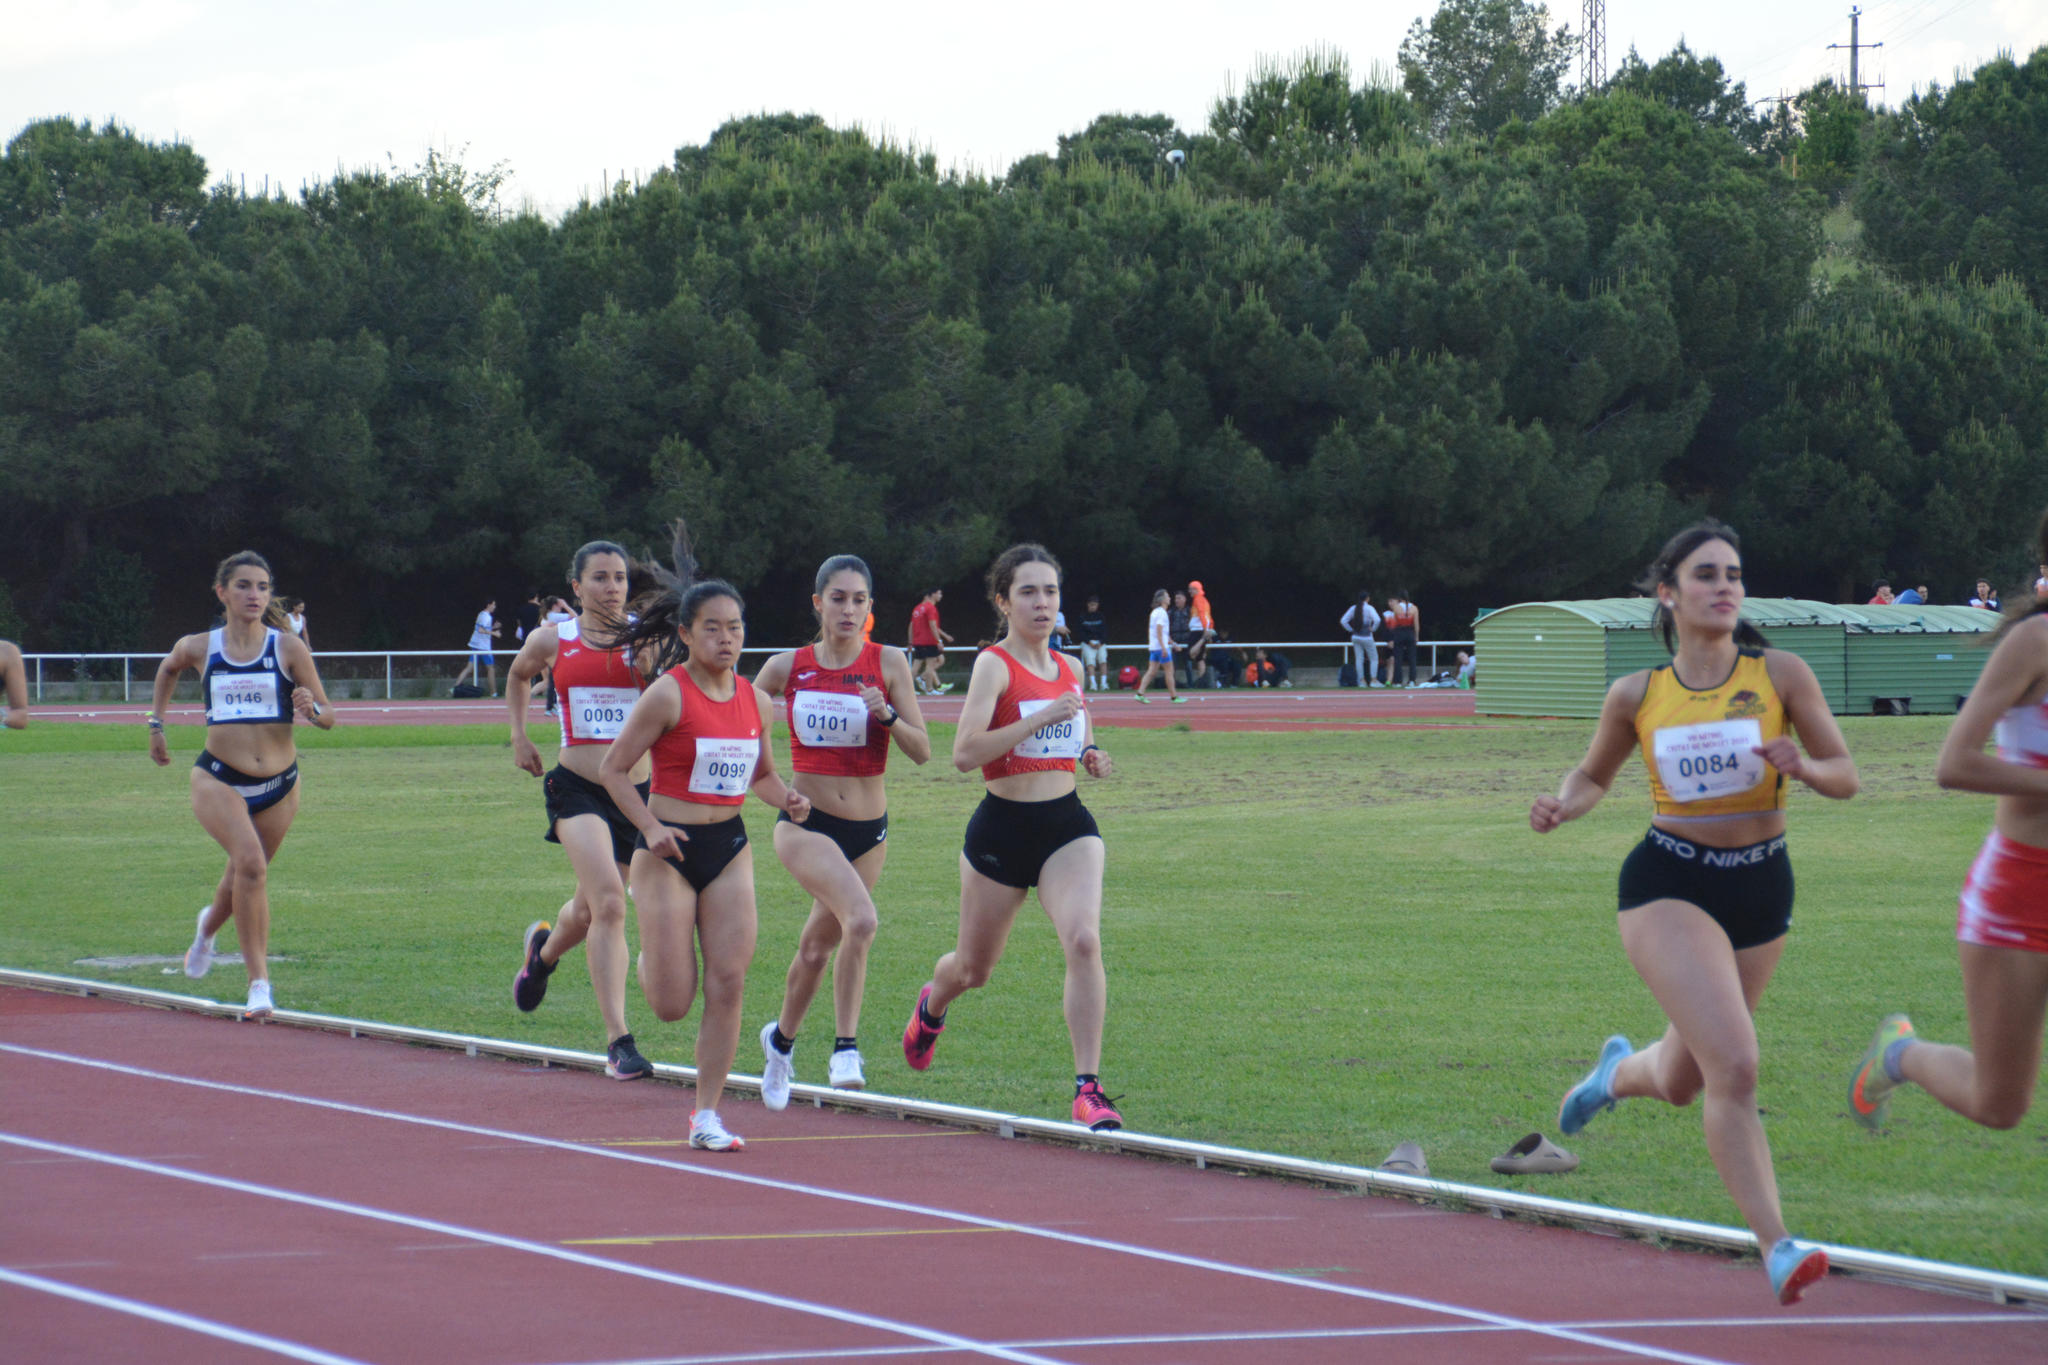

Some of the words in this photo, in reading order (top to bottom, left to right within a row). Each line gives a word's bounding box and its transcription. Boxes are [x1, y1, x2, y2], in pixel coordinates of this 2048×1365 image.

[225, 692, 262, 705] 0146
[584, 708, 624, 722] 0003
[807, 714, 847, 731] 0101
[1035, 723, 1072, 740] 0060
[708, 762, 746, 778] 0099
[1679, 752, 1740, 777] 0084
[1649, 828, 1696, 859] PRO
[1703, 845, 1766, 867] NIKE
